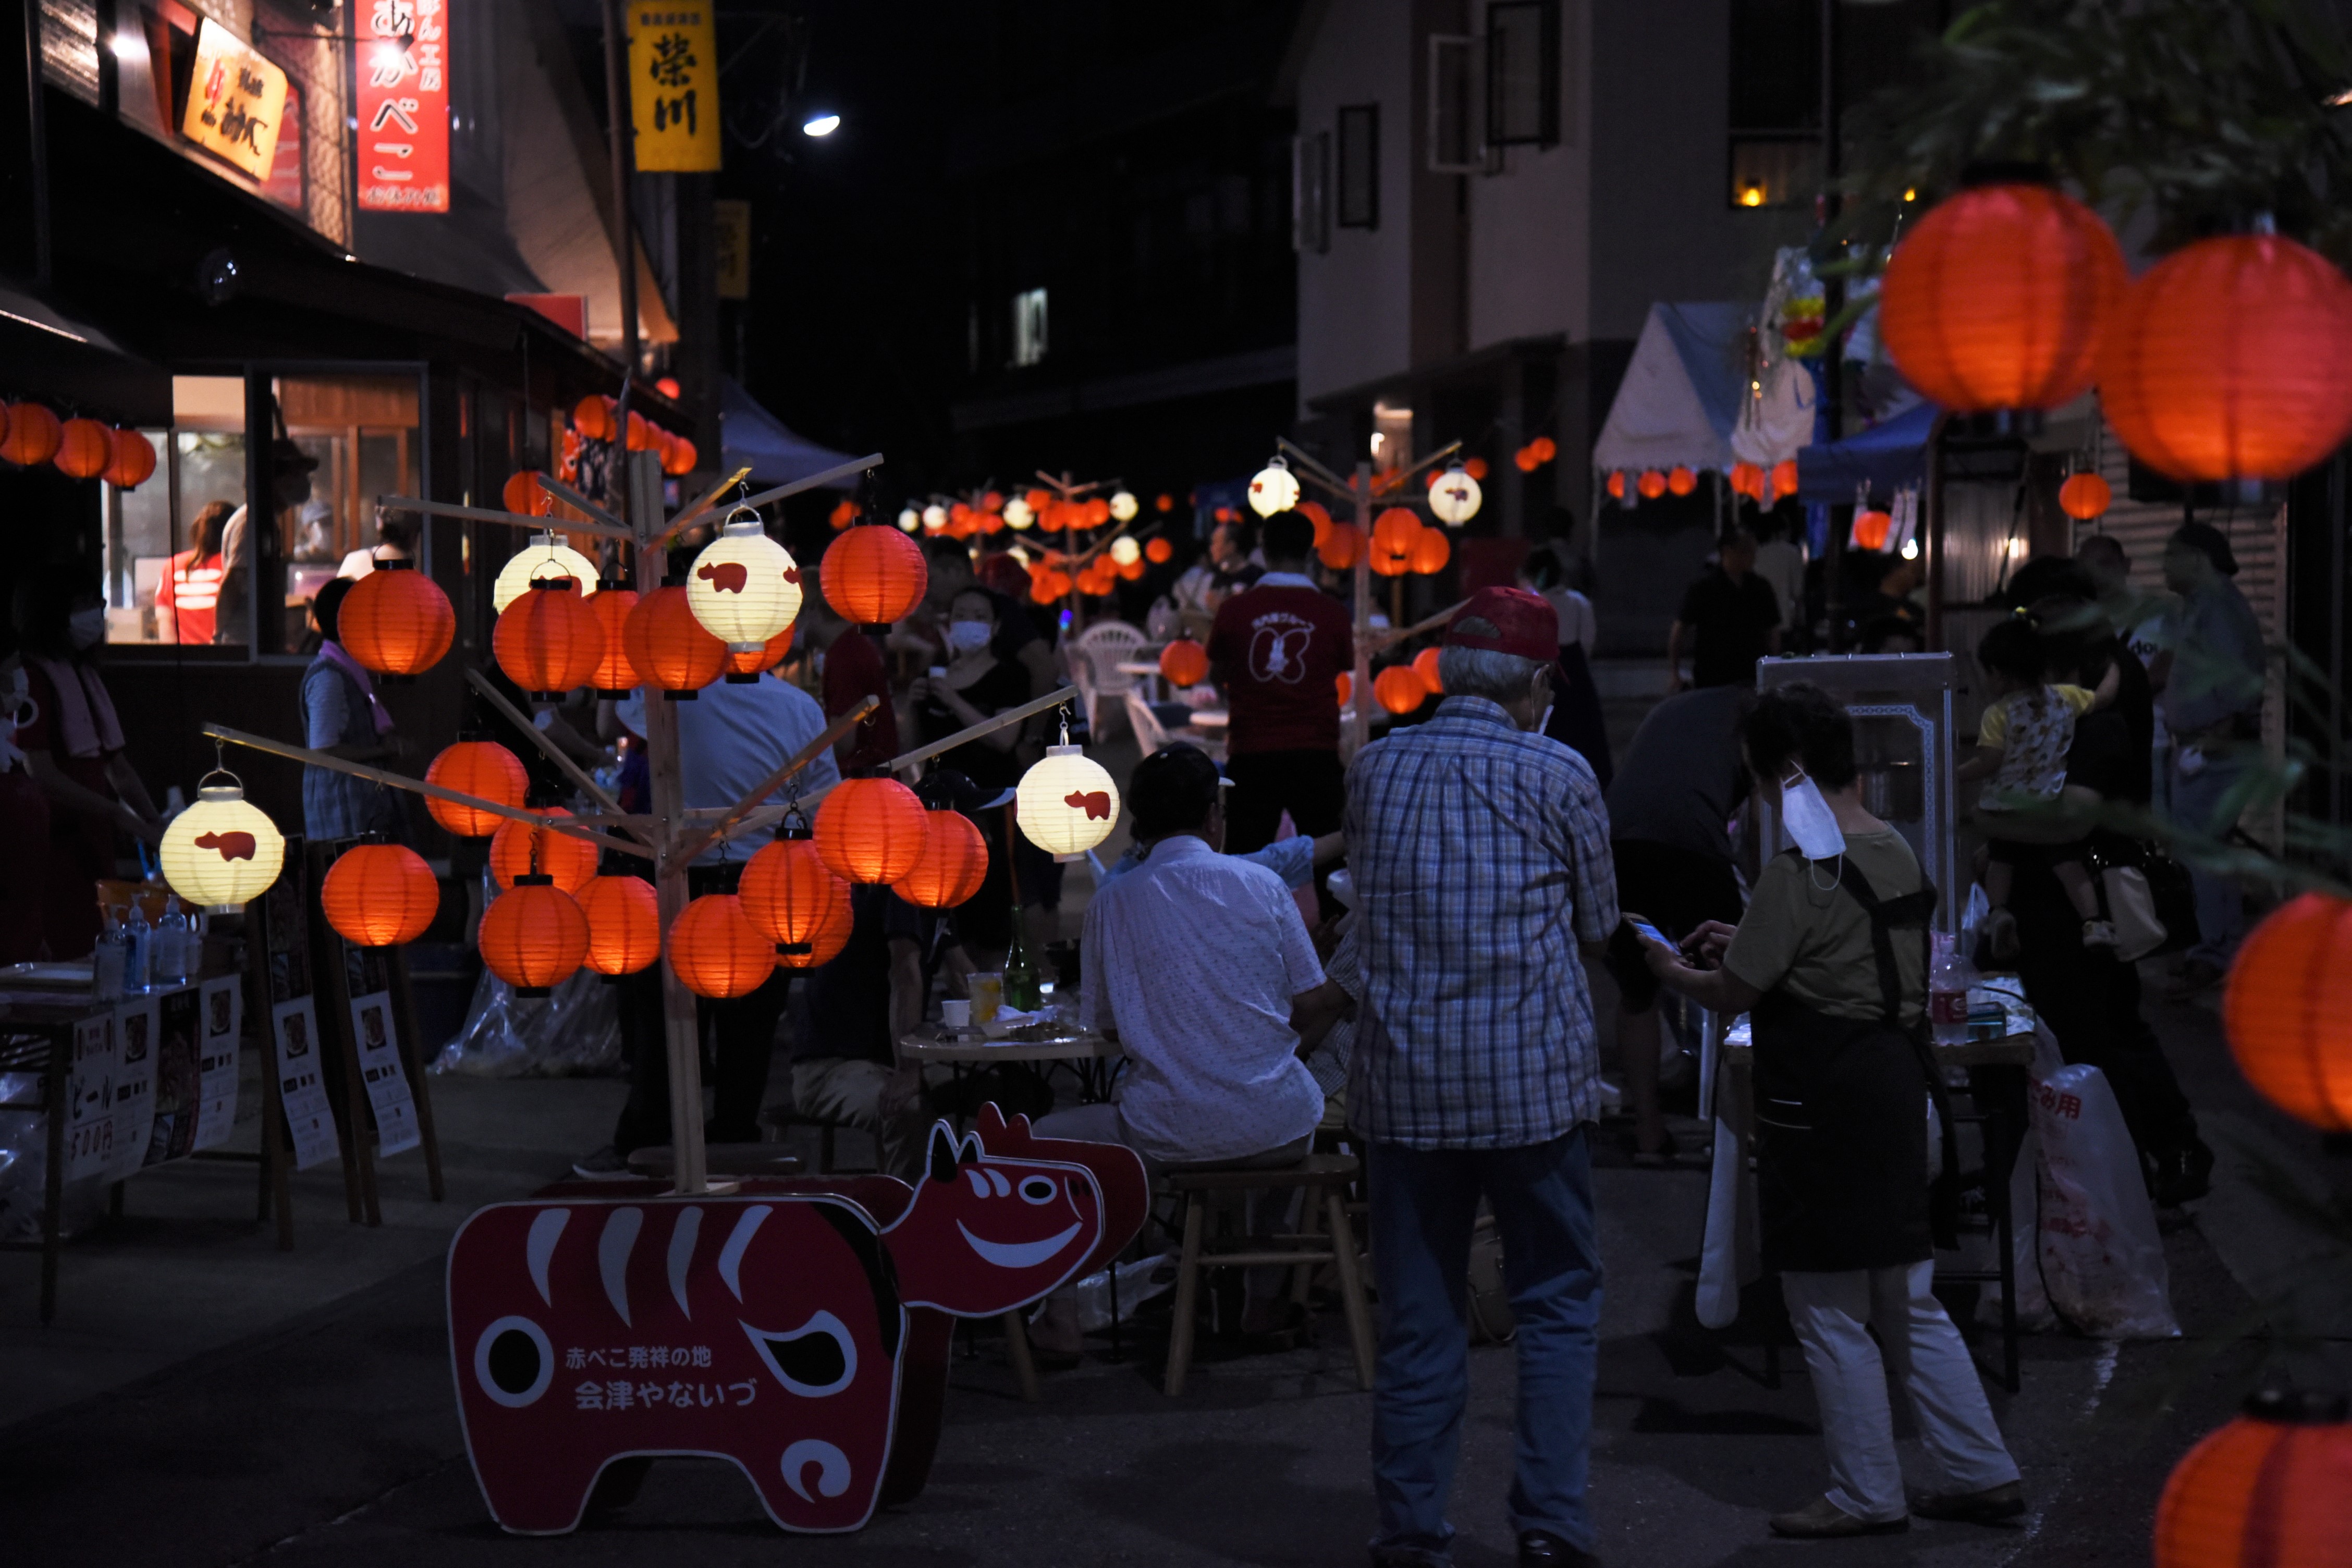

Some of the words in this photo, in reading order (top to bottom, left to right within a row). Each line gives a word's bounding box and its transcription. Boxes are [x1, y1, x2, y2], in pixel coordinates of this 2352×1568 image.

[566, 1345, 712, 1369] 赤べこ発祥の地
[574, 1377, 757, 1411] 会津やないづ
